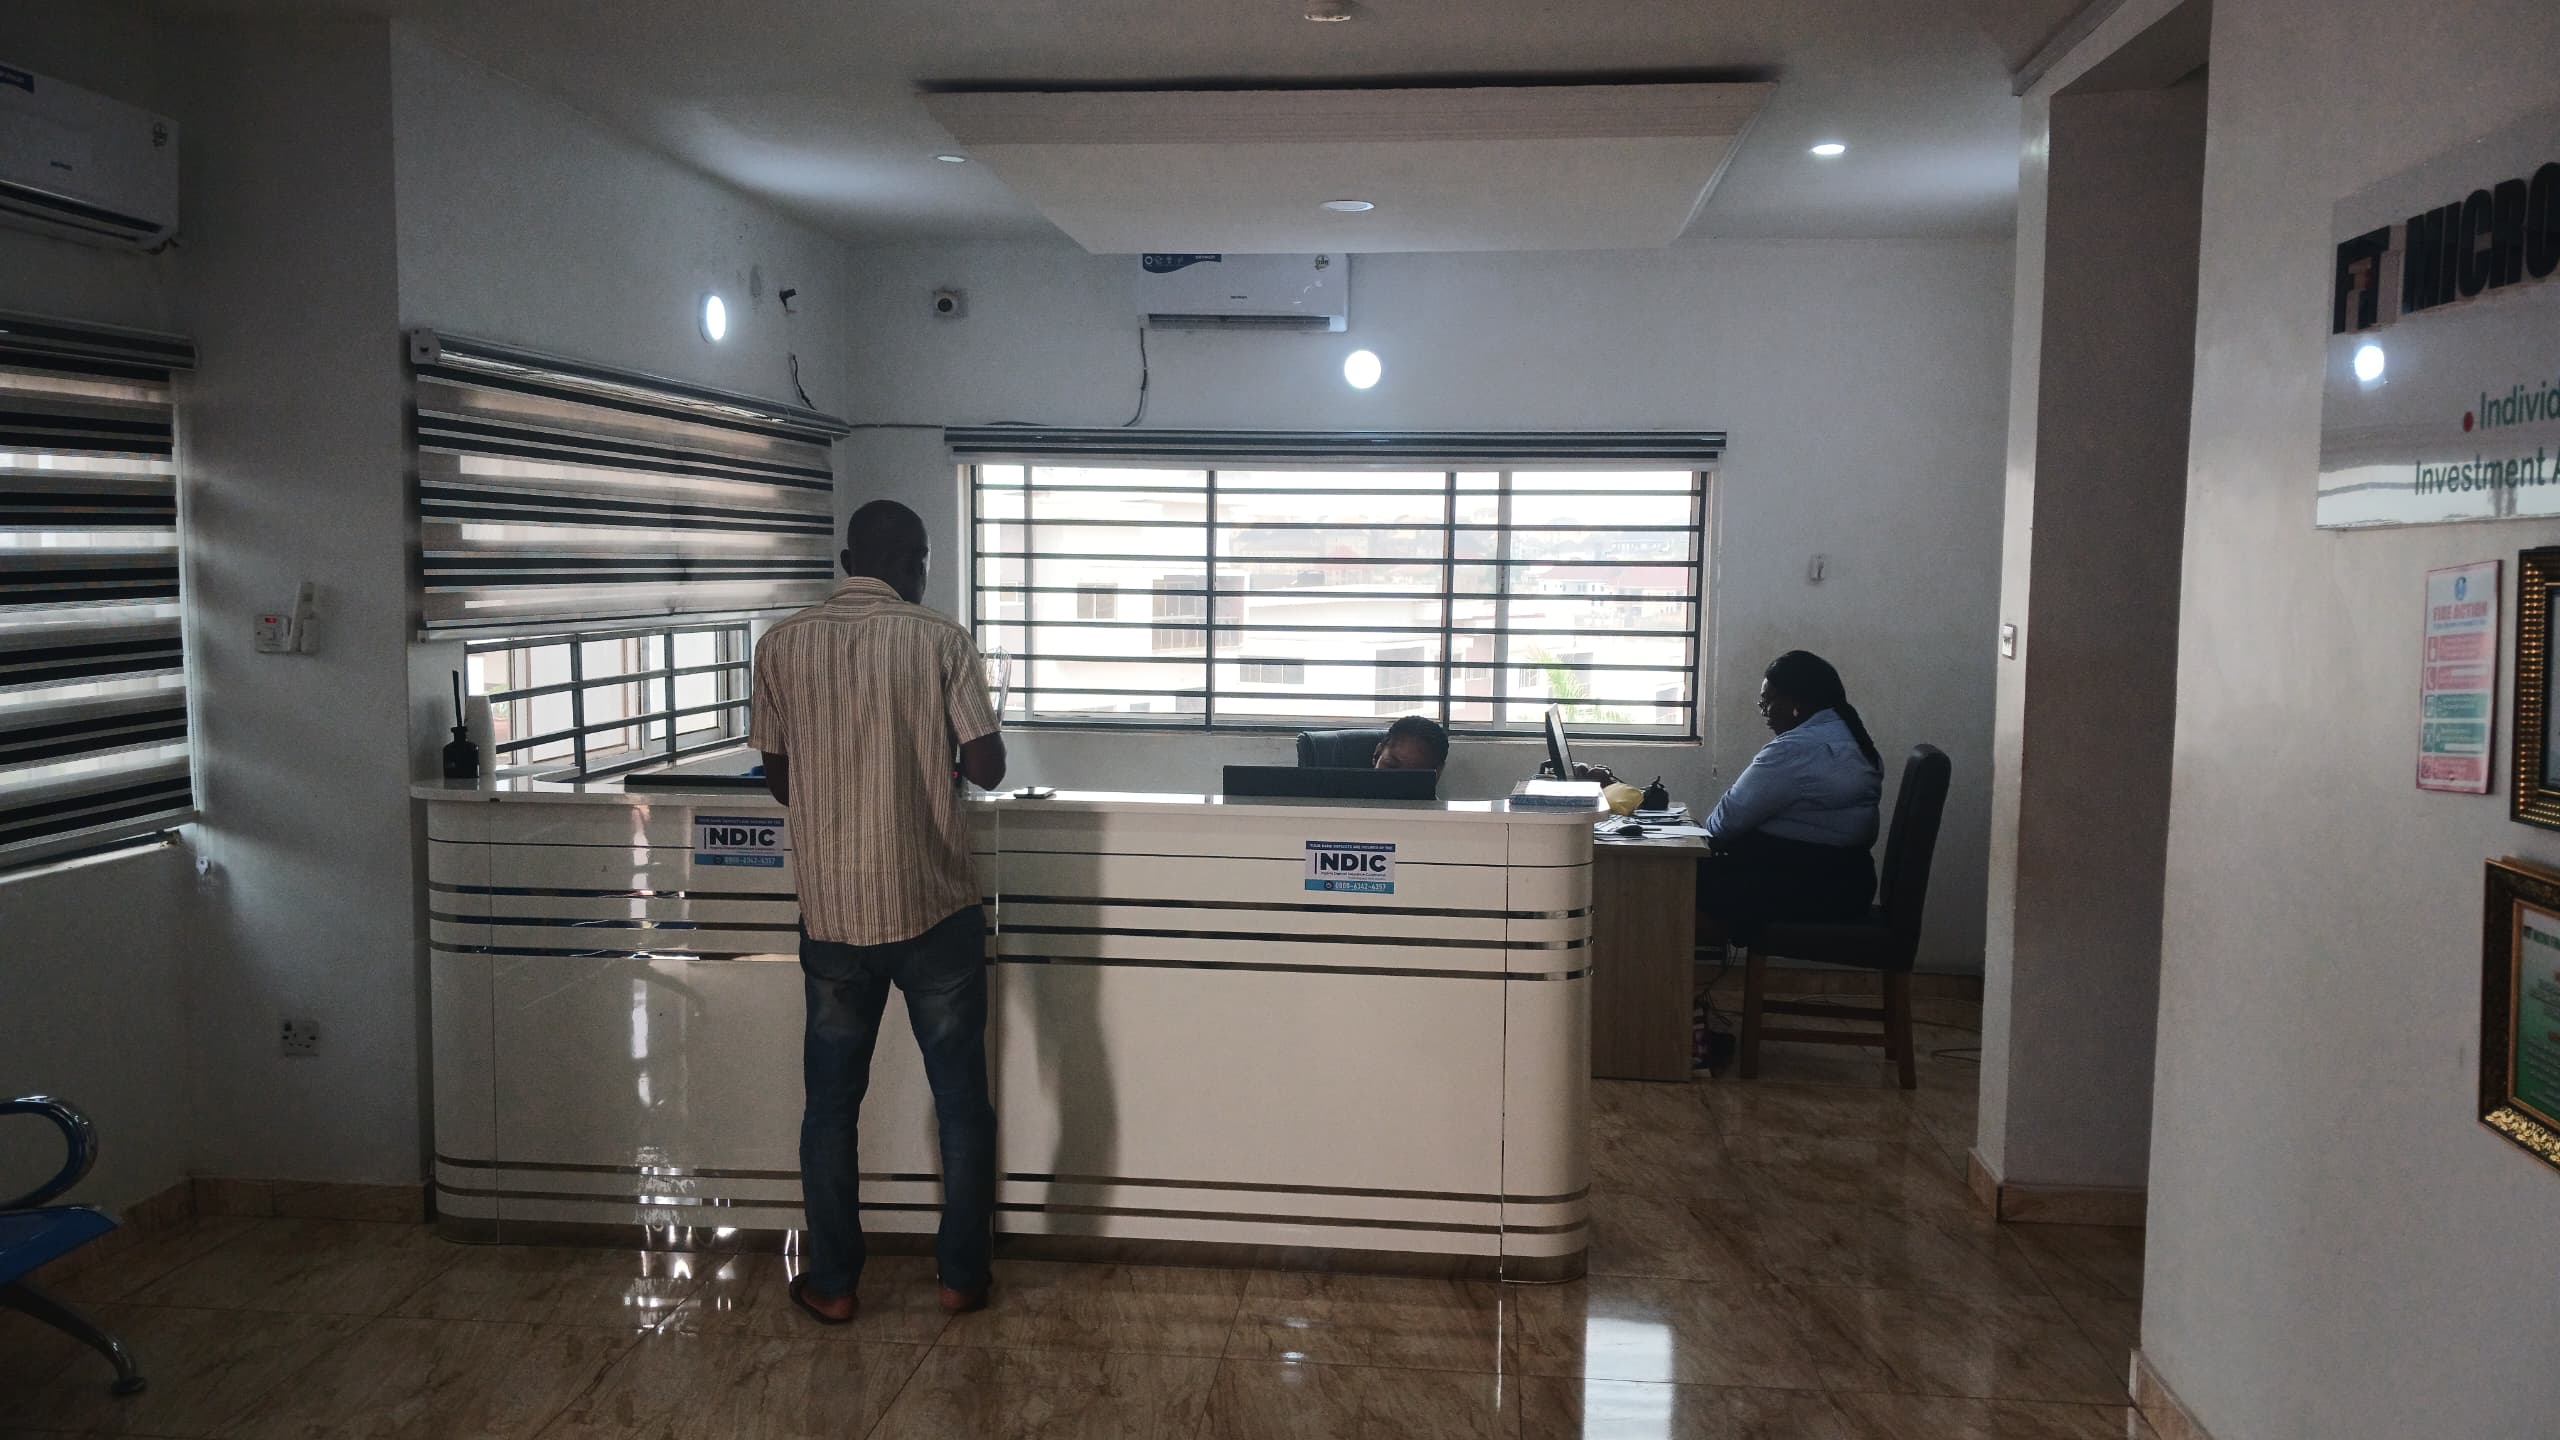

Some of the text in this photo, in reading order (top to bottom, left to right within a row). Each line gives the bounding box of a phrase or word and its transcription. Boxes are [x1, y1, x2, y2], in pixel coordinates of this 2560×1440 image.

[2415, 446, 2546, 495] Investment
[709, 827, 776, 846] NDIC
[1320, 853, 1387, 872] NDIC
